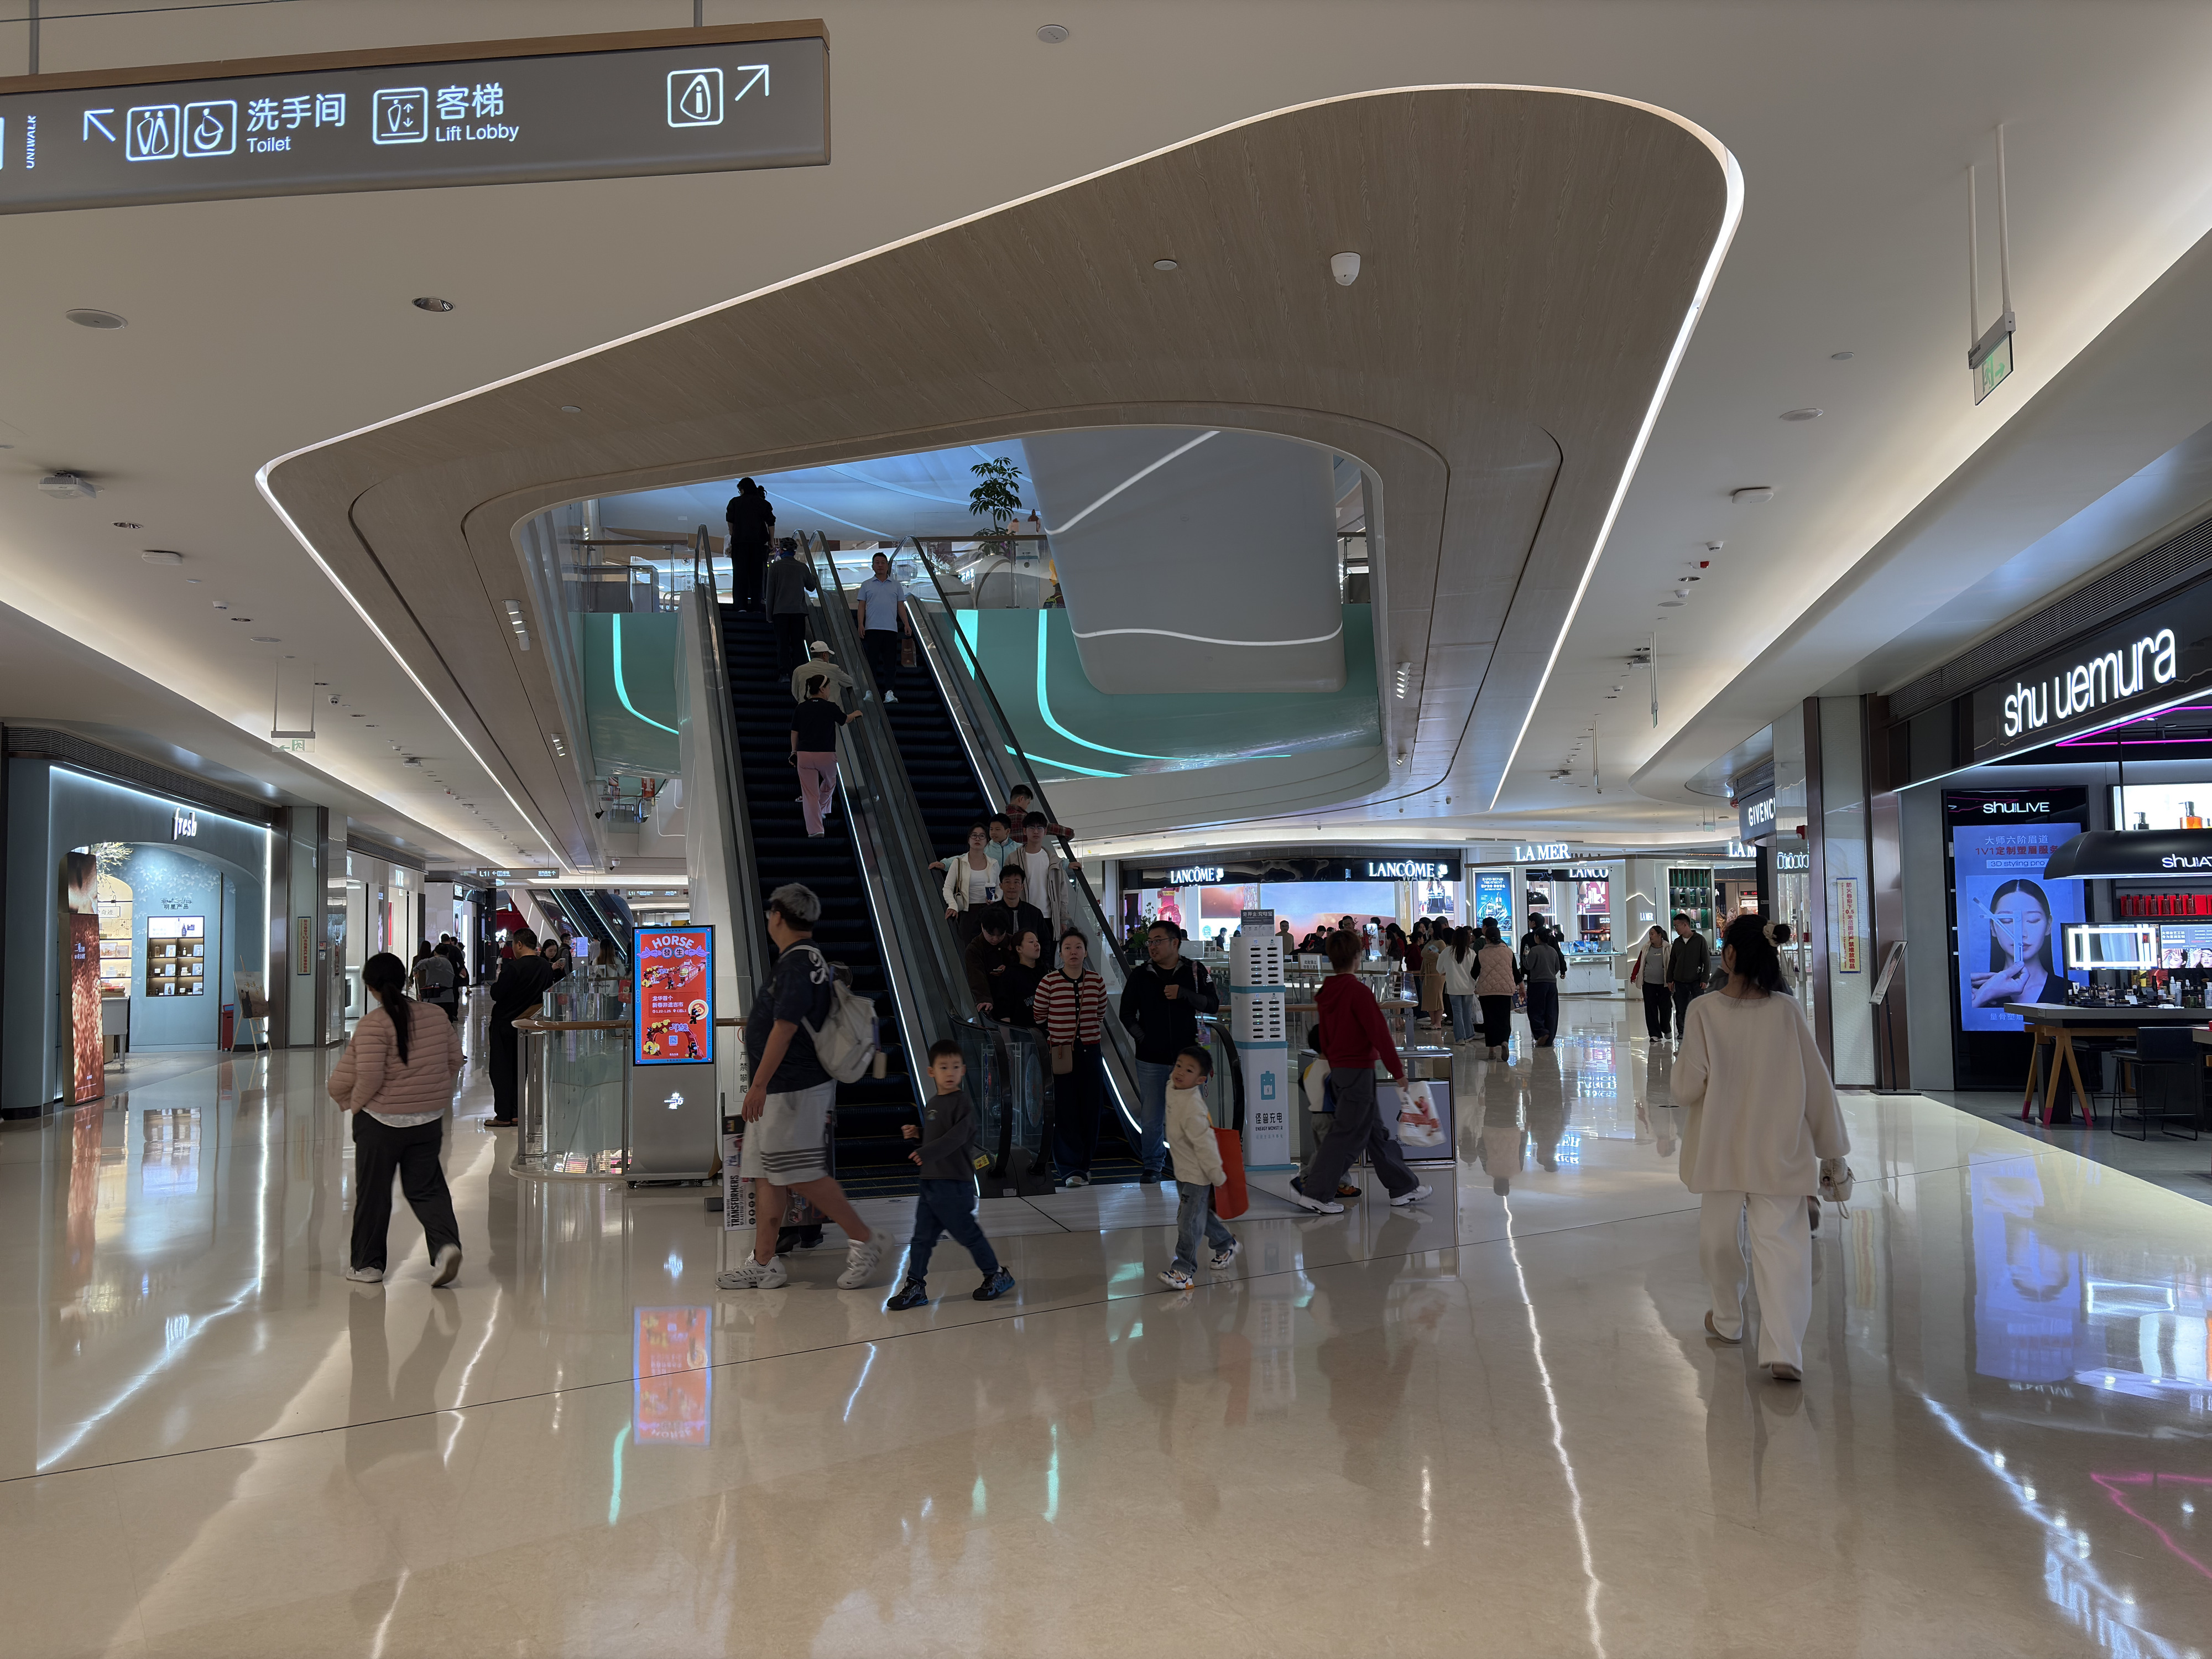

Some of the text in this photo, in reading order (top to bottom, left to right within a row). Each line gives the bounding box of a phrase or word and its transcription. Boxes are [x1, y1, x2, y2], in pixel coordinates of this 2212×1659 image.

[436, 82, 504, 120] 客梯
[247, 93, 346, 132] 洗手间
[27, 115, 36, 169] UNIWALK
[436, 123, 520, 142] Lift Lobby
[247, 136, 291, 153] Toilet
[2005, 628, 2177, 737] shu uemura
[173, 807, 197, 841] fresh
[1985, 834, 2049, 845] 大师六阶眉道
[1515, 843, 1572, 862] LA MER
[1728, 841, 1746, 858] LA
[1369, 860, 1435, 877] LANCÔME
[1569, 869, 1609, 878] LANCO
[2004, 860, 2029, 868] styling
[1170, 866, 1215, 884] LANCÔME
[1845, 882, 1855, 969] 防火卷帘下0.5米范围内严禁堆放物品
[651, 935, 695, 949] HORSE
[739, 1051, 748, 1093] 严禁攀爬
[1255, 1113, 1282, 1124] 怪兽充电
[730, 1175, 739, 1227] TRANSFORMERS
